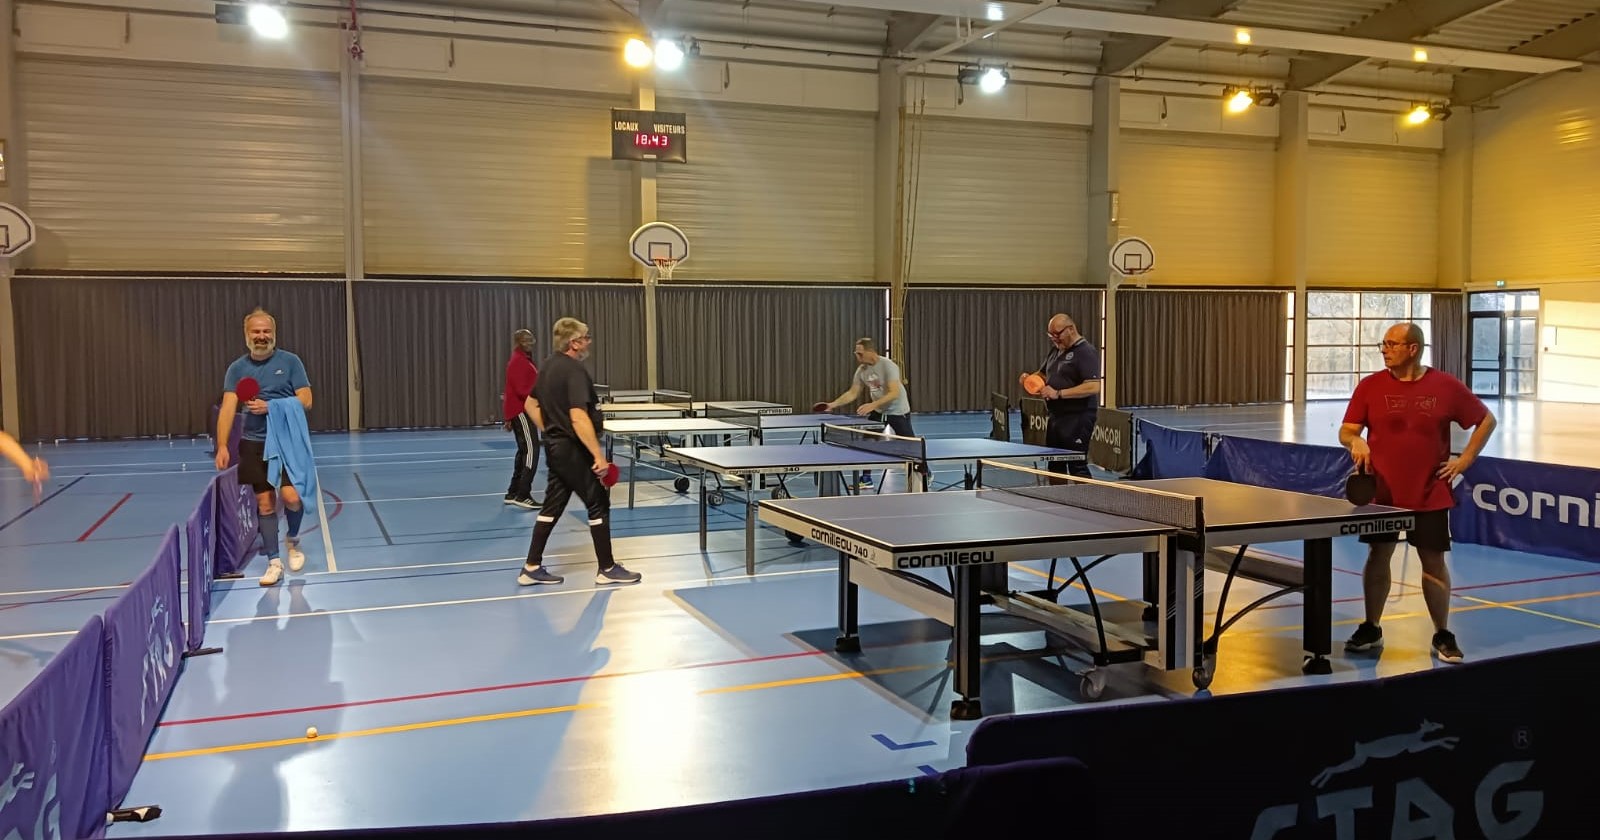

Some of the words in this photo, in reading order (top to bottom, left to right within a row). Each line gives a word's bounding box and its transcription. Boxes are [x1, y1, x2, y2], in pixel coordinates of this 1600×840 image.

[614, 121, 639, 131] LOCAUX
[653, 124, 685, 134] VISITEURS
[1340, 517, 1412, 535] cornilleau
[811, 527, 852, 551] cornilleau
[853, 544, 869, 559] 740
[897, 549, 995, 569] cornilleau
